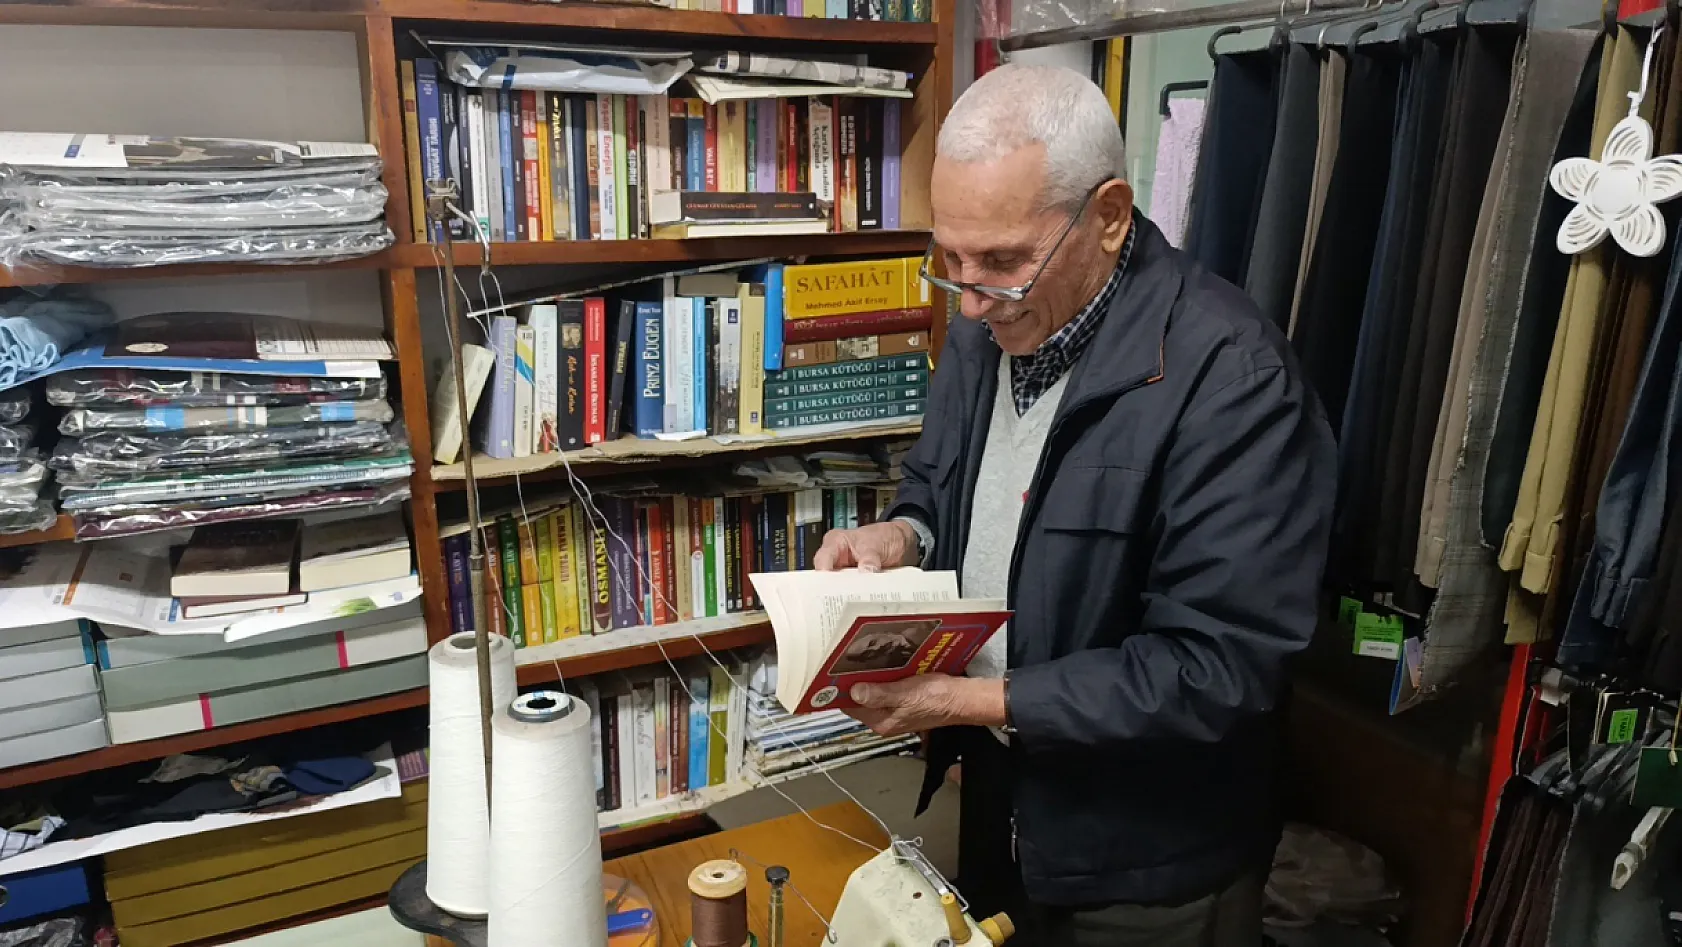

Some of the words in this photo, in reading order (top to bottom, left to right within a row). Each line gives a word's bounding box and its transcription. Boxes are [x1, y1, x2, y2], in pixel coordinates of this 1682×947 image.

[821, 125, 830, 155] Kartal
[602, 134, 613, 177] Enerjisi
[796, 267, 895, 294] SAFAHÂT
[642, 317, 661, 360] EUGEN
[642, 362, 661, 398] PRINZ
[797, 366, 830, 378] BURSA
[832, 362, 872, 375] KÜTÜĞÜ
[799, 381, 831, 393] BURSA
[832, 377, 872, 390] KÜTÜĞÜ
[797, 396, 828, 409] BURSA
[832, 392, 871, 405] KÜTÜĞÜ
[799, 411, 830, 424] BURSA
[832, 407, 872, 420] KÜTÜĞÜ
